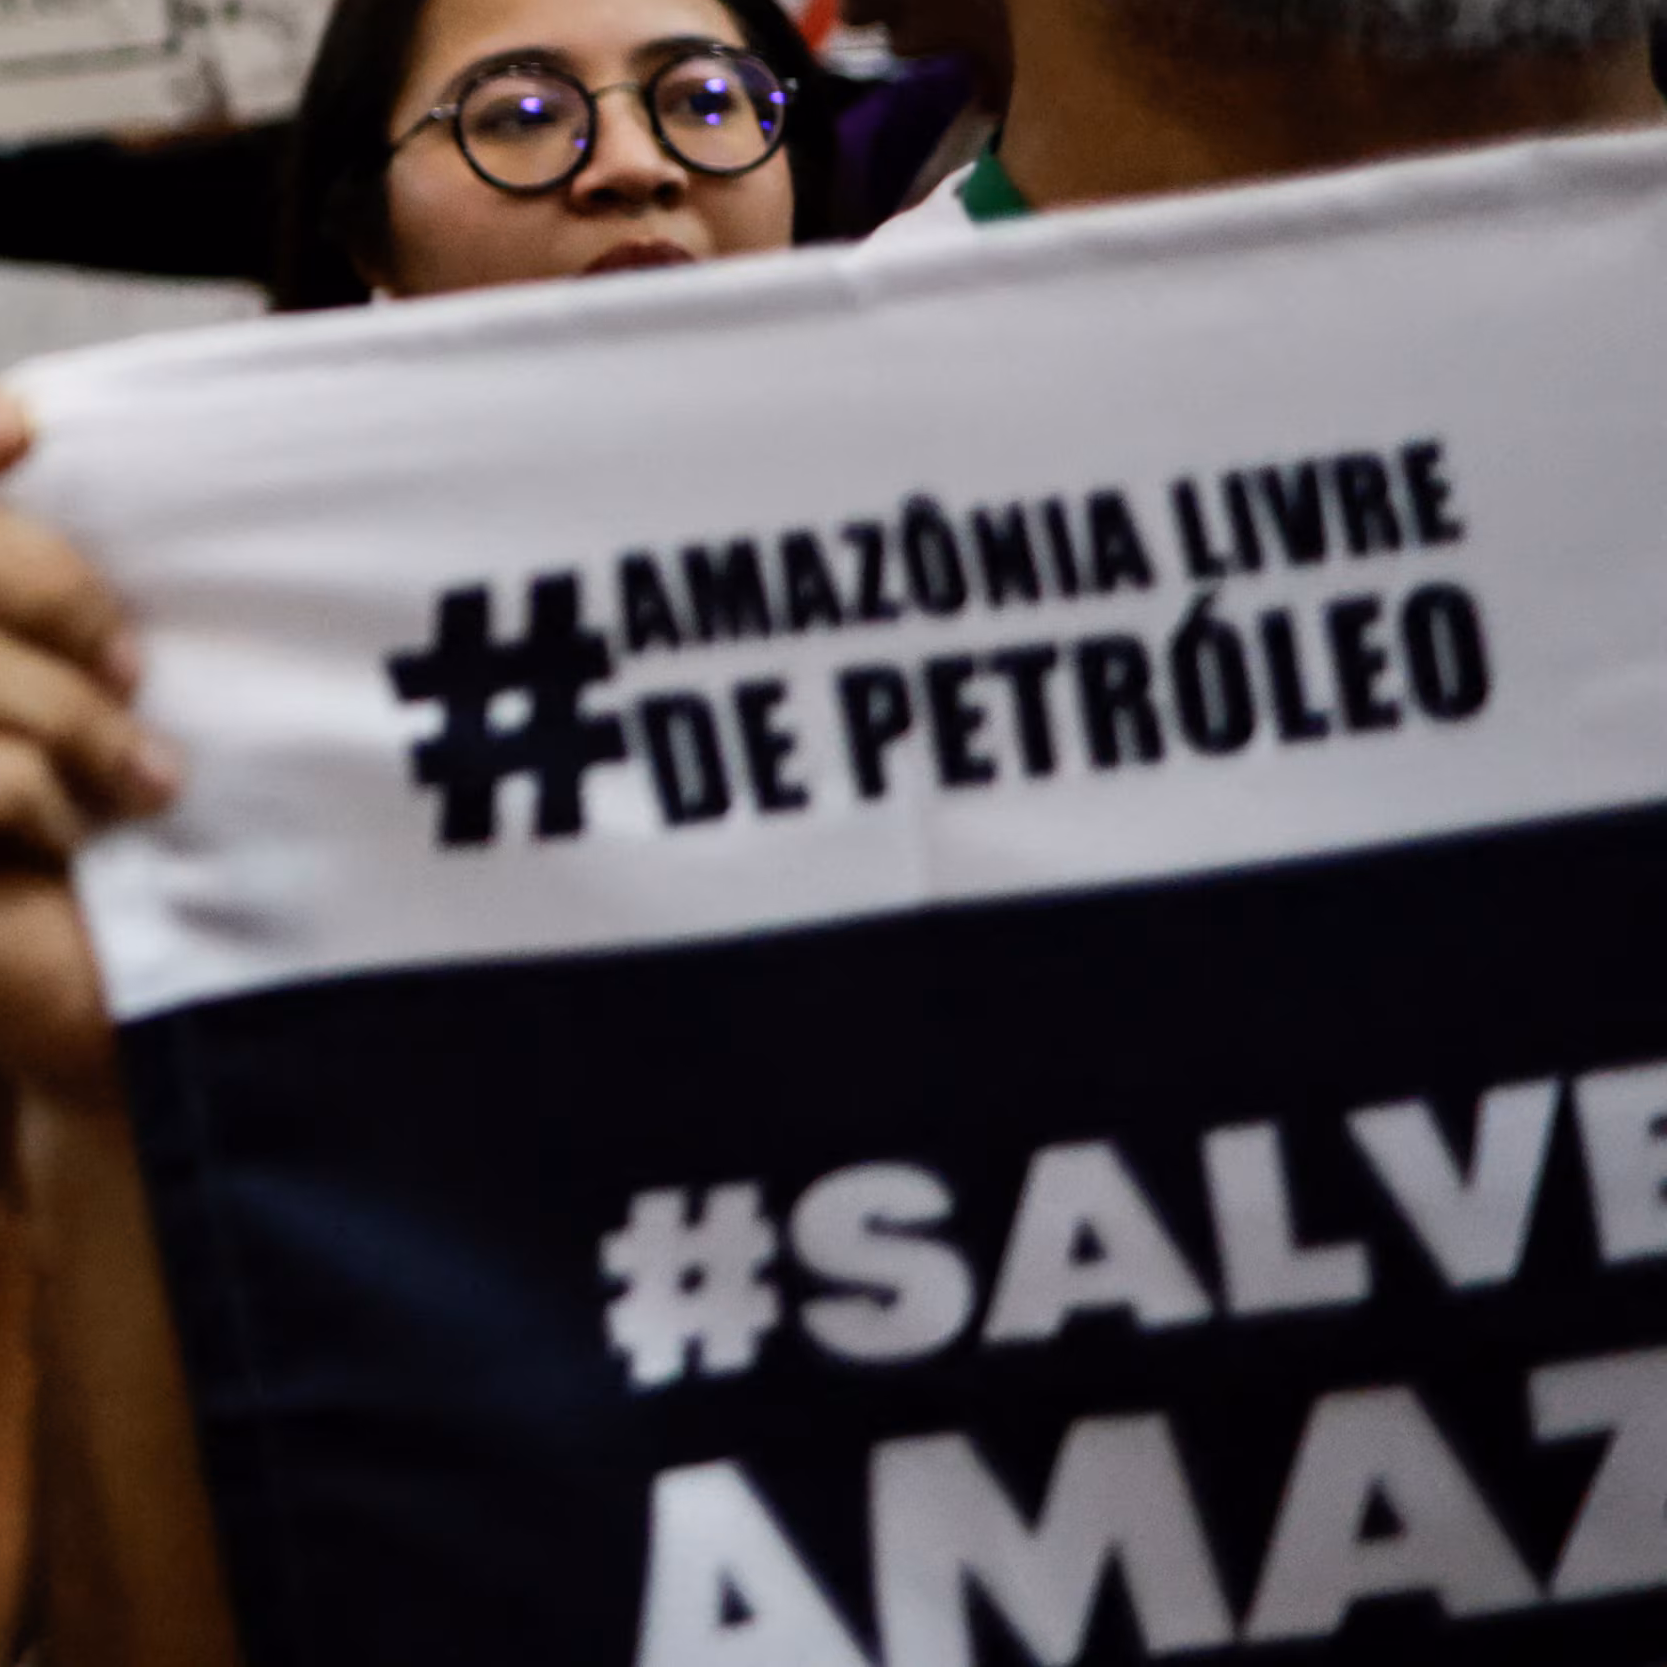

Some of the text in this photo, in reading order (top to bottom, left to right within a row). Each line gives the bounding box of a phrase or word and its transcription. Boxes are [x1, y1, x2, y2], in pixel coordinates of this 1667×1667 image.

[613, 439, 1467, 657] AMAZÔNIA LIVRE
[629, 580, 1493, 829] DE PETRÓLEO
[601, 1059, 1667, 1390] #SALVE
